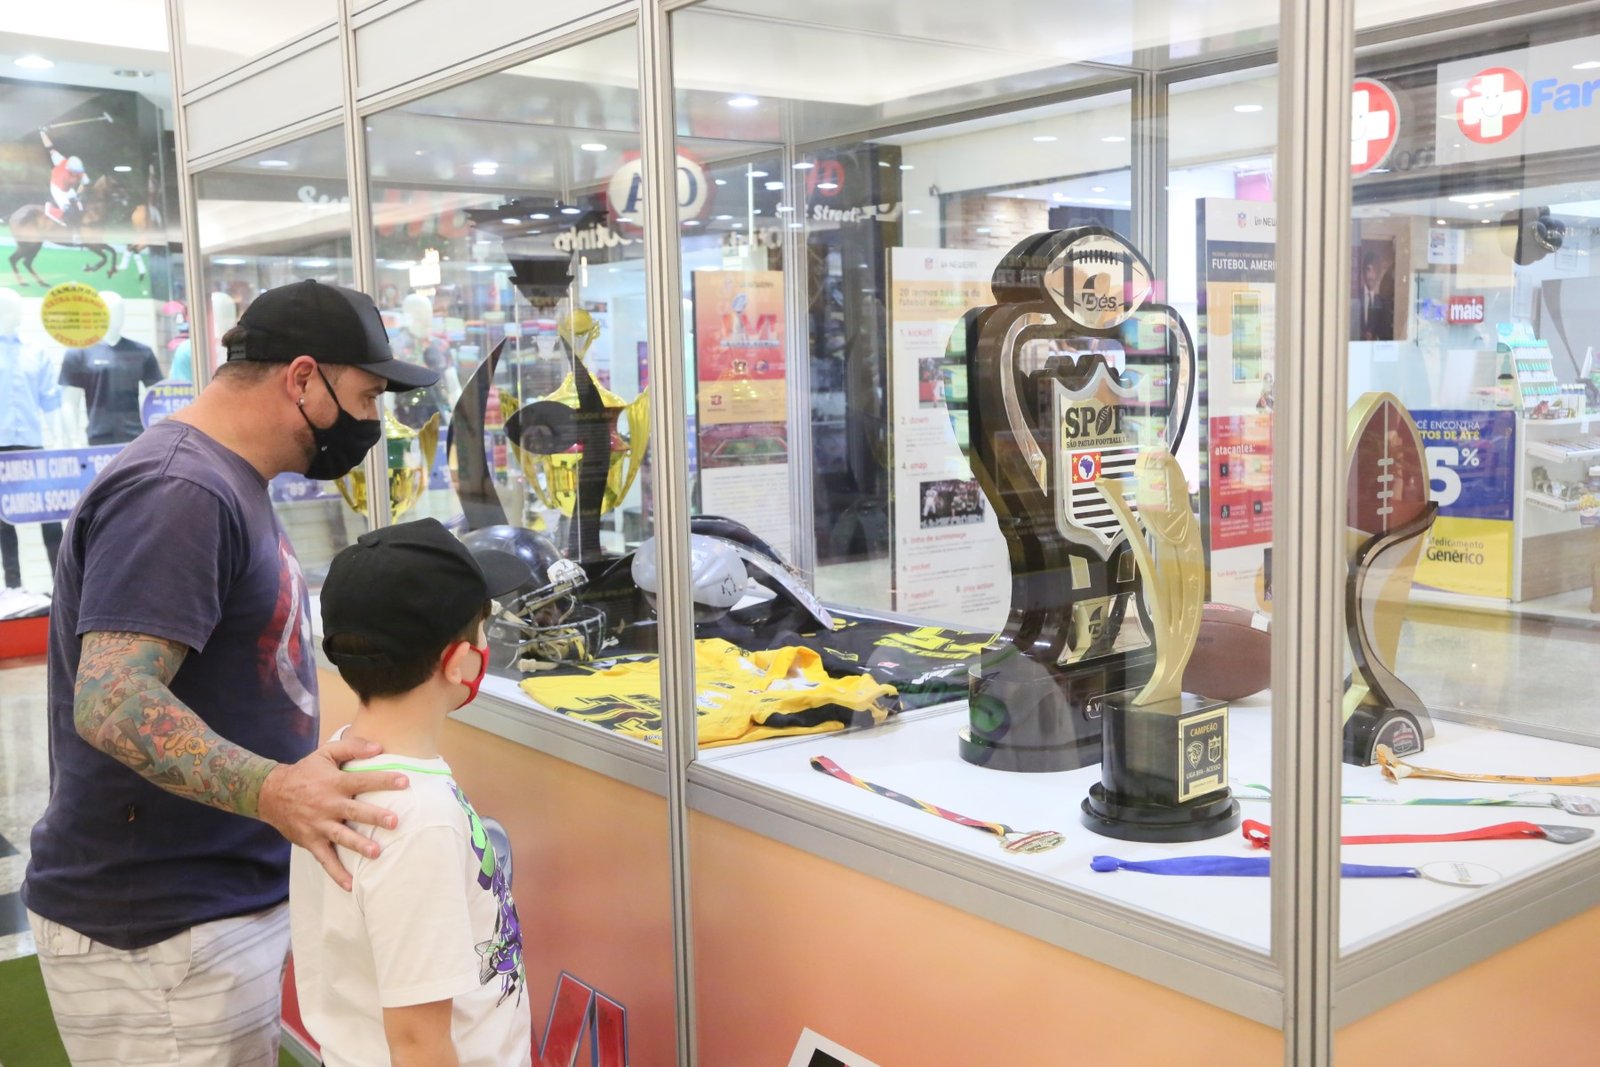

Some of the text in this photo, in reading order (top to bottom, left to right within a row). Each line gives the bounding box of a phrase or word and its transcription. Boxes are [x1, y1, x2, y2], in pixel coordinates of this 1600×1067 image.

[1212, 258, 1277, 271] FUTEBOL AMERI
[1451, 298, 1483, 320] mais
[1416, 420, 1480, 430] CÊ ENCONTRA
[1419, 431, 1440, 440] TOS
[1444, 431, 1457, 440] DE
[1078, 438, 1095, 448] PAULO
[1215, 444, 1256, 456] atacantes:
[2, 491, 43, 515] CAMISA
[1426, 546, 1484, 565] Genérico
